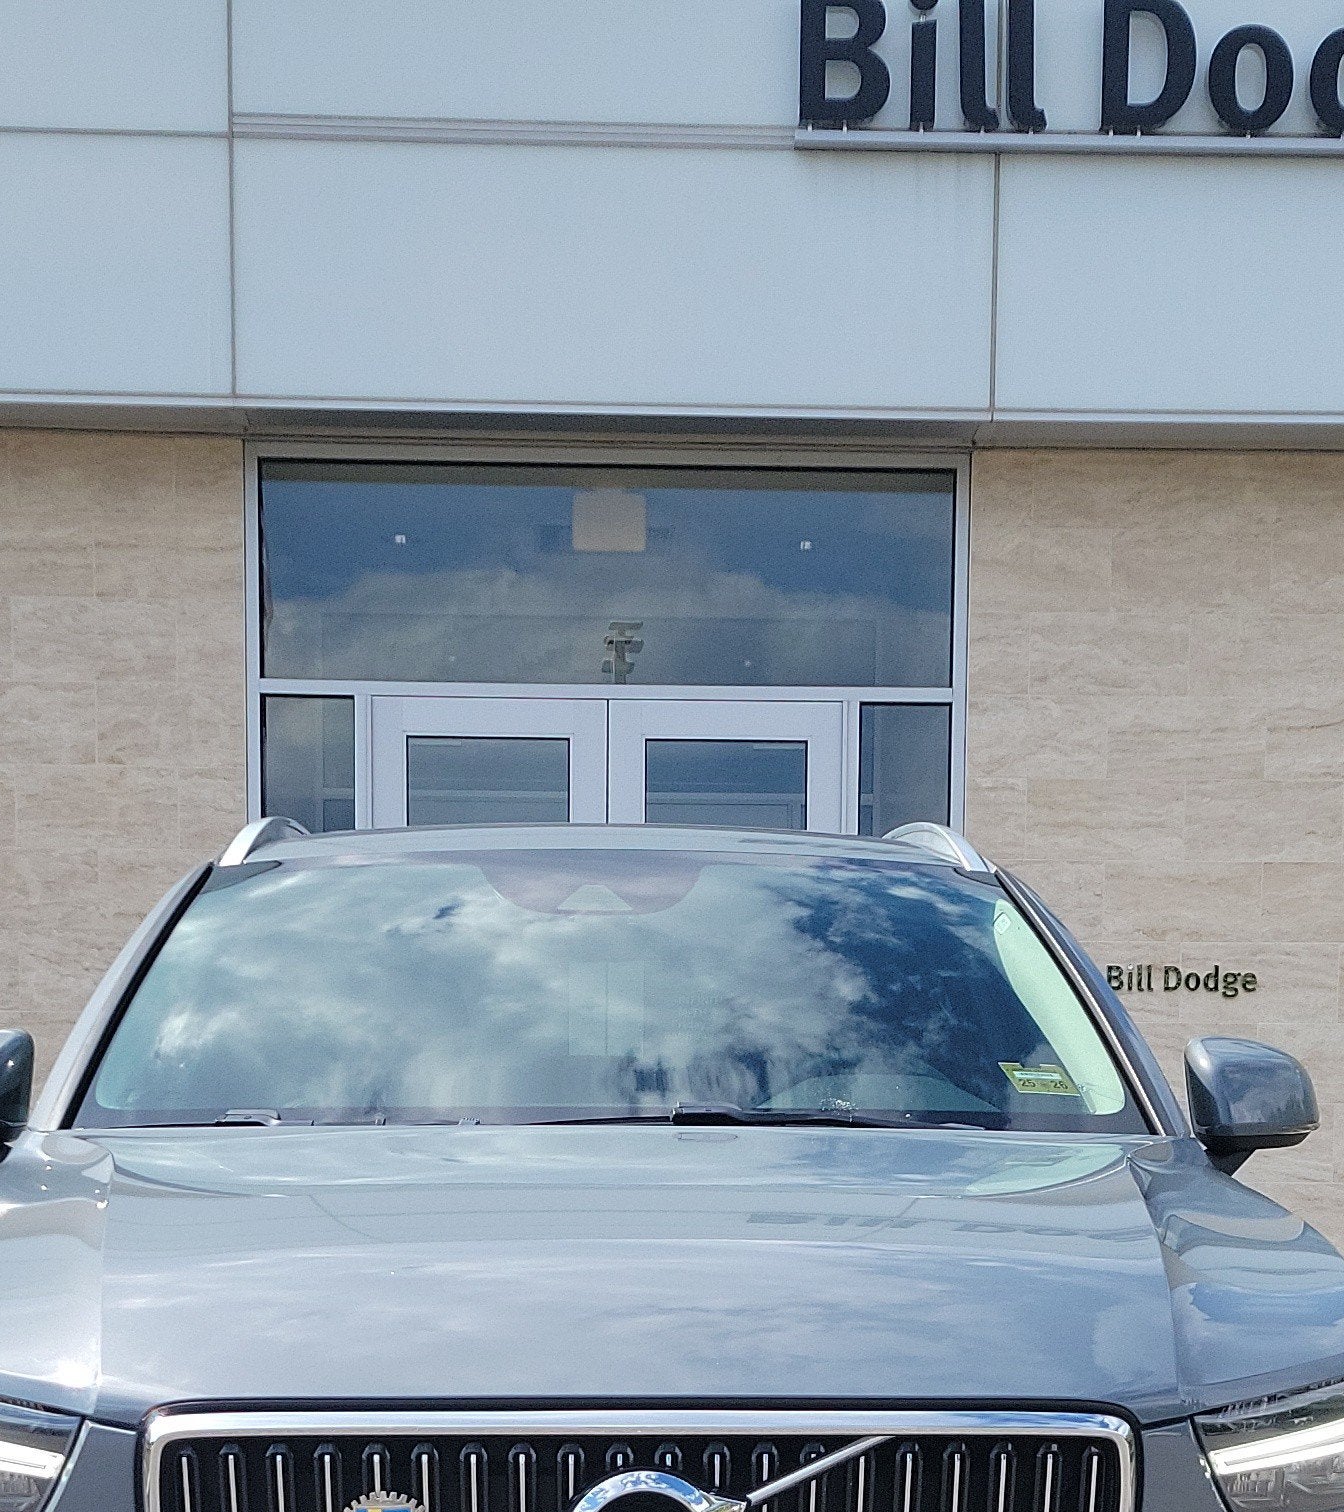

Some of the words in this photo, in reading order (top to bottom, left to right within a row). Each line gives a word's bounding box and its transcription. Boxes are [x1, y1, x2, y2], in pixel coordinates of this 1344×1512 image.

[798, 0, 1046, 132] Bill
[1106, 963, 1154, 992] Bill
[1163, 964, 1258, 998] Dodge
